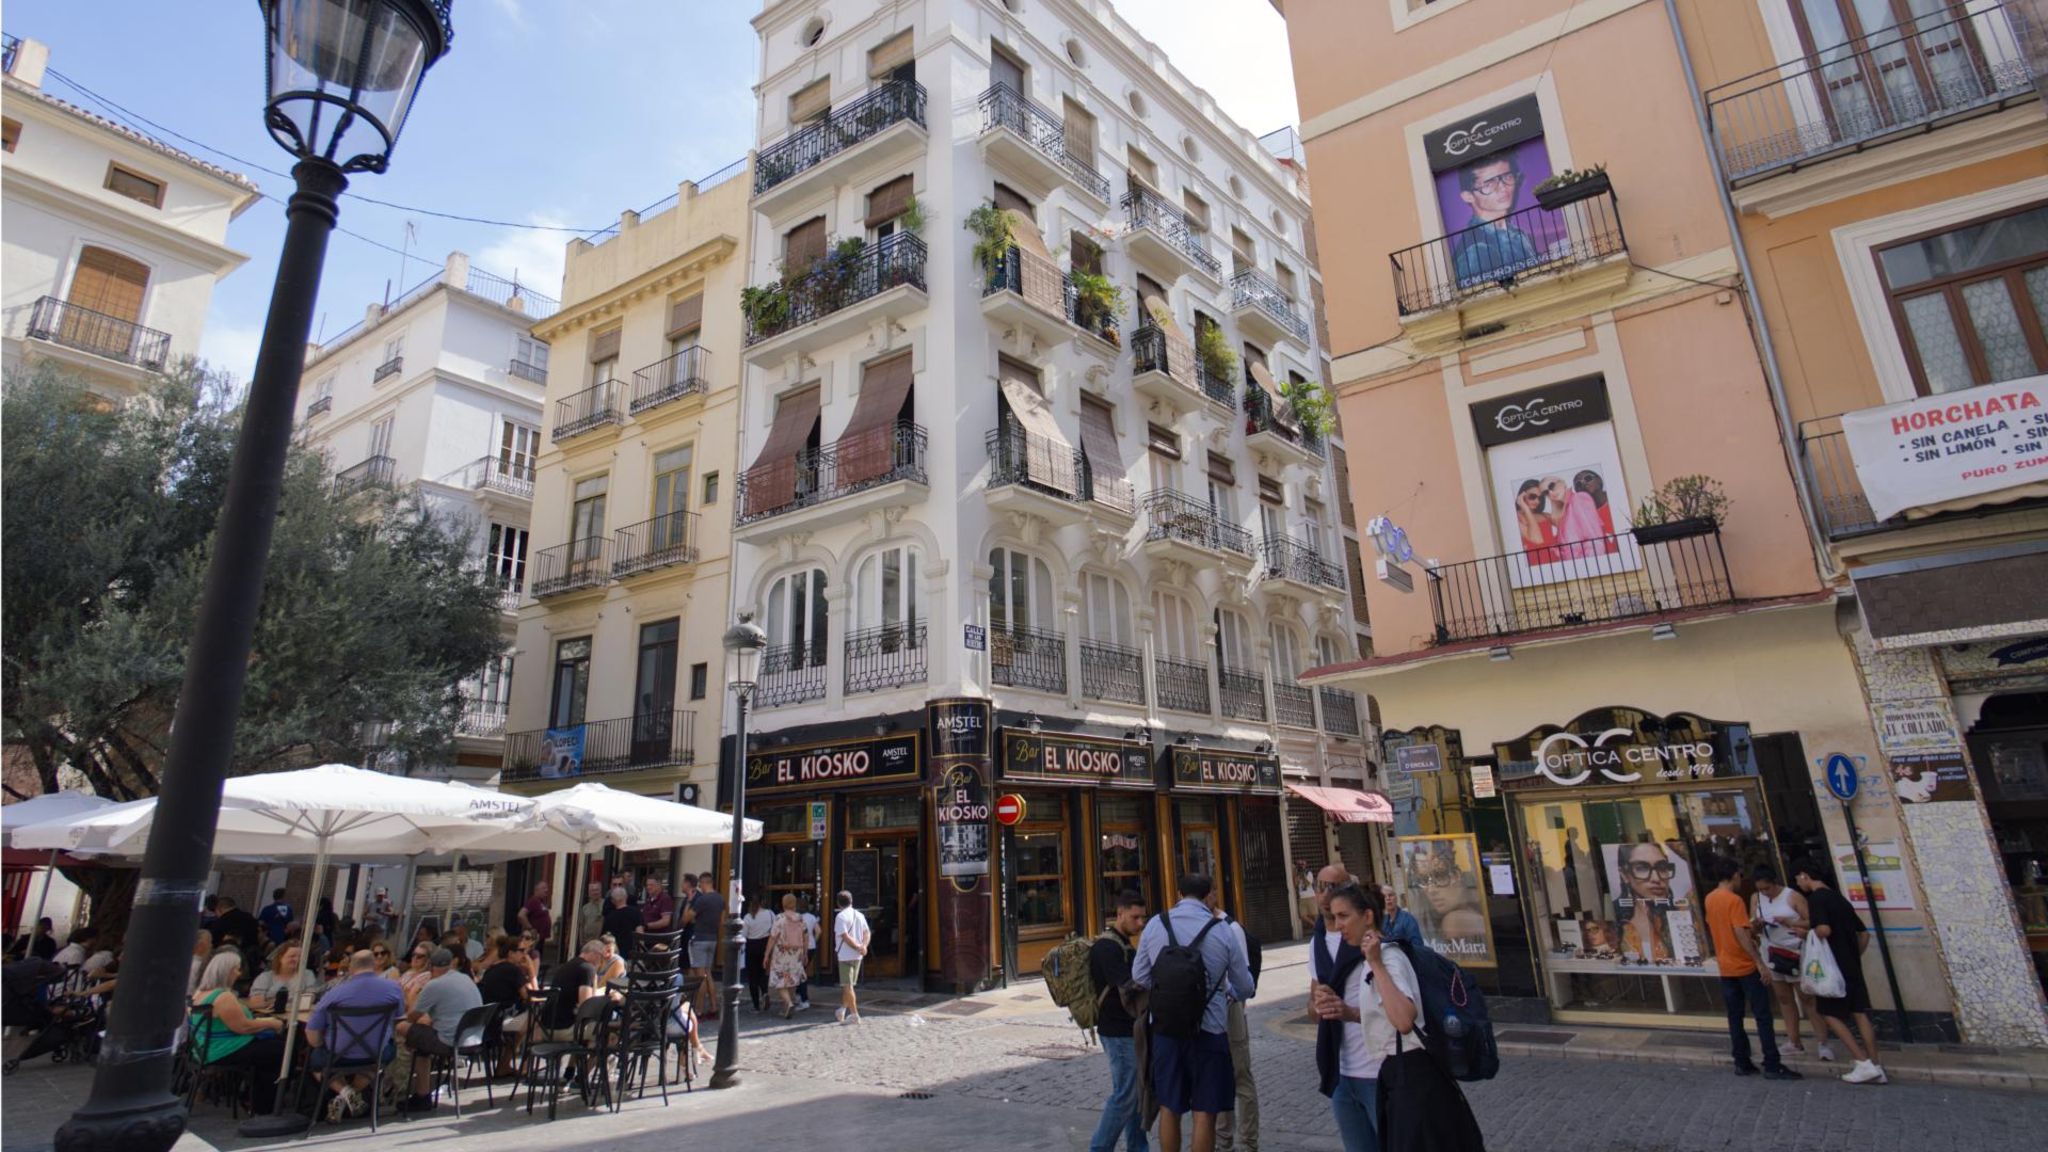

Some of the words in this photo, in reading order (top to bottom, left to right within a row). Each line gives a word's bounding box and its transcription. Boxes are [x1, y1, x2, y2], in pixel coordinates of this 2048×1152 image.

[1450, 132, 1484, 149] OPTICA
[1484, 117, 1522, 137] CENTRO
[1502, 409, 1539, 425] OPTICA
[1540, 399, 1583, 416] CENTRO
[1891, 391, 2041, 435] HORCHATA
[1911, 434, 1936, 449] SIN
[1942, 419, 2009, 443] CANELA
[1915, 449, 1941, 463] SIN
[1946, 437, 1996, 455] LIMÓN
[2015, 441, 2042, 454] SIN
[1961, 464, 2008, 480] PURO
[937, 716, 982, 730] AMSTEL
[1902, 720, 1947, 735] COLLADO
[882, 747, 908, 758] AMSTEL
[1016, 739, 1040, 762] Bar
[1045, 746, 1060, 769] EL
[1066, 748, 1120, 773] KIOSKO
[1545, 750, 1621, 769] OPTICA
[1625, 742, 1714, 763] CENTRO
[749, 757, 773, 780] Bar
[777, 760, 794, 782] EL
[801, 750, 870, 780] KIOSKO
[1202, 760, 1214, 779] EL
[1218, 761, 1256, 782] KIOSKO
[1656, 767, 1685, 778] desde
[1688, 763, 1715, 776] 1976
[952, 772, 973, 787] Bar
[956, 789, 971, 803] EL
[469, 799, 520, 813] AMSTEL
[938, 804, 988, 822] KIOSKO
[1618, 897, 1689, 907] ETRO
